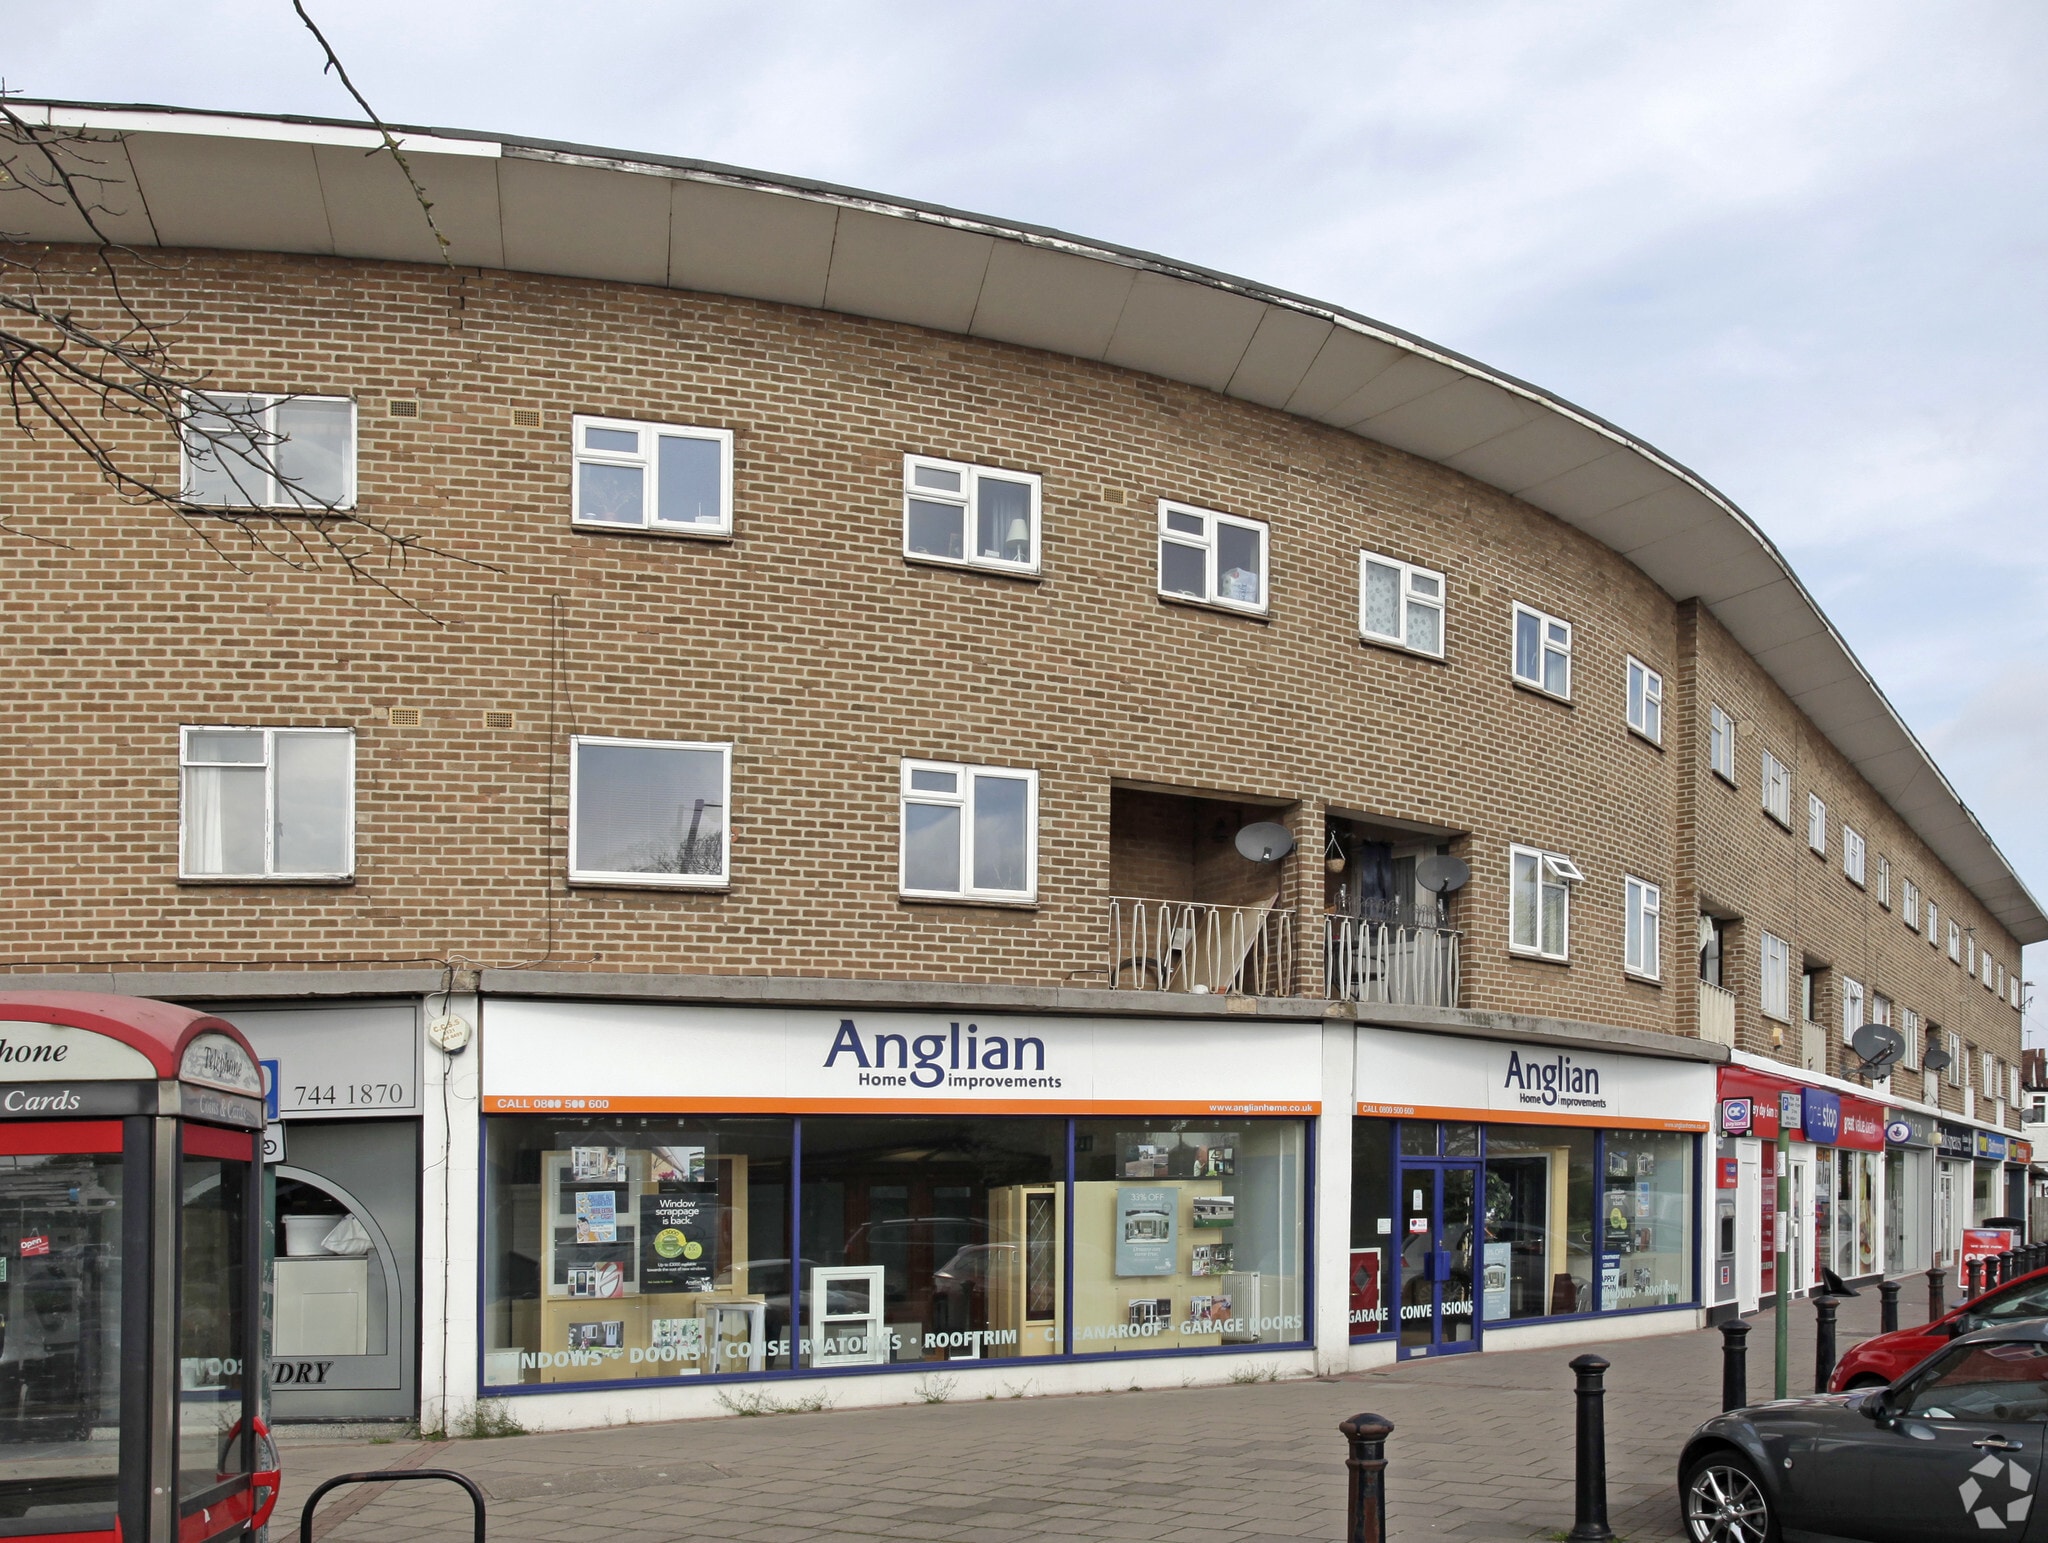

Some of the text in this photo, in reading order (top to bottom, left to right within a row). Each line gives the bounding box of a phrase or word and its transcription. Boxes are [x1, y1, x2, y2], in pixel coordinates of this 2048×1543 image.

[822, 1018, 1045, 1088] Anglian
[203, 1046, 243, 1078] Telephone
[858, 1072, 1062, 1090] Home improvements
[1503, 1050, 1600, 1106] Anglian
[4, 1090, 81, 1112] Cards
[293, 1083, 403, 1106] 744 1870
[1519, 1092, 1607, 1108] Home improvements
[199, 1094, 247, 1120] Coins & Cards
[497, 1098, 609, 1110] CALL 0800 500 600
[1209, 1103, 1313, 1113] www.anglianhome.co.uk
[1362, 1104, 1378, 1113] CALL
[1822, 1104, 1838, 1136] stop
[659, 1198, 696, 1208] Window
[1148, 1192, 1165, 1201] OFF
[655, 1208, 699, 1218] scrappage
[662, 1215, 693, 1225] is back.
[21, 1237, 42, 1250] Open
[1349, 1307, 1389, 1323] GARAGE
[629, 1345, 701, 1364] DOORS
[924, 1328, 1017, 1349] ROOFTRIM
[1179, 1318, 1244, 1335] GARAGE
[1250, 1314, 1302, 1331] DOORS
